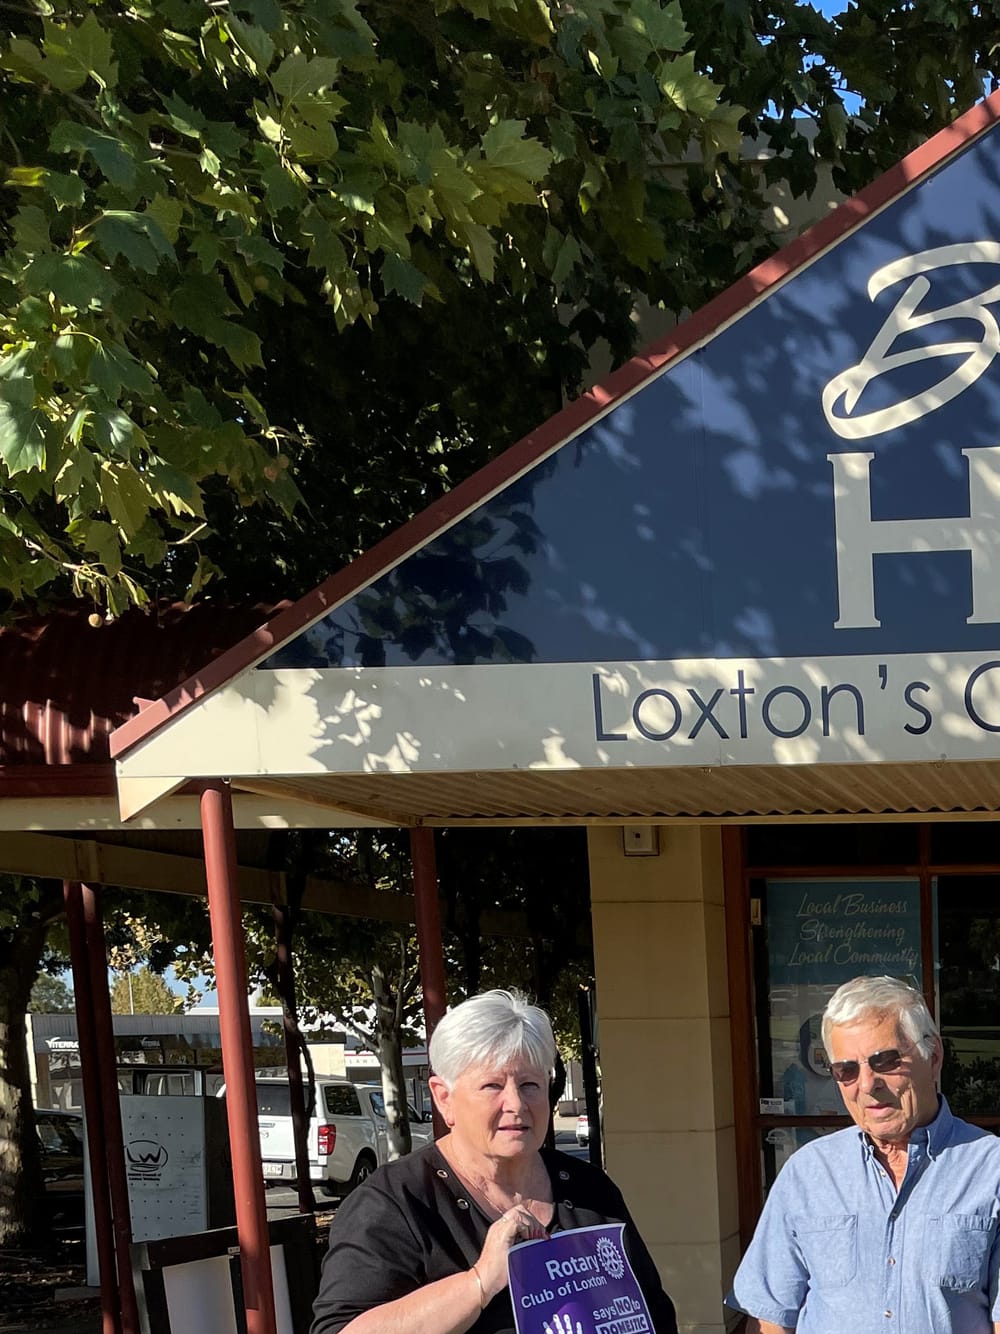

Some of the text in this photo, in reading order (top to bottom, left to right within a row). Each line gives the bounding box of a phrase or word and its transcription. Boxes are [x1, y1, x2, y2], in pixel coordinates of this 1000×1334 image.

[594, 665, 934, 743] Loxton's
[796, 892, 908, 917] Local Business
[800, 919, 905, 945] Strengthening
[787, 942, 919, 970] Local Community
[545, 1254, 601, 1281] Rotary
[521, 1275, 608, 1309] Club of Loxton
[593, 1297, 642, 1322] says NO to
